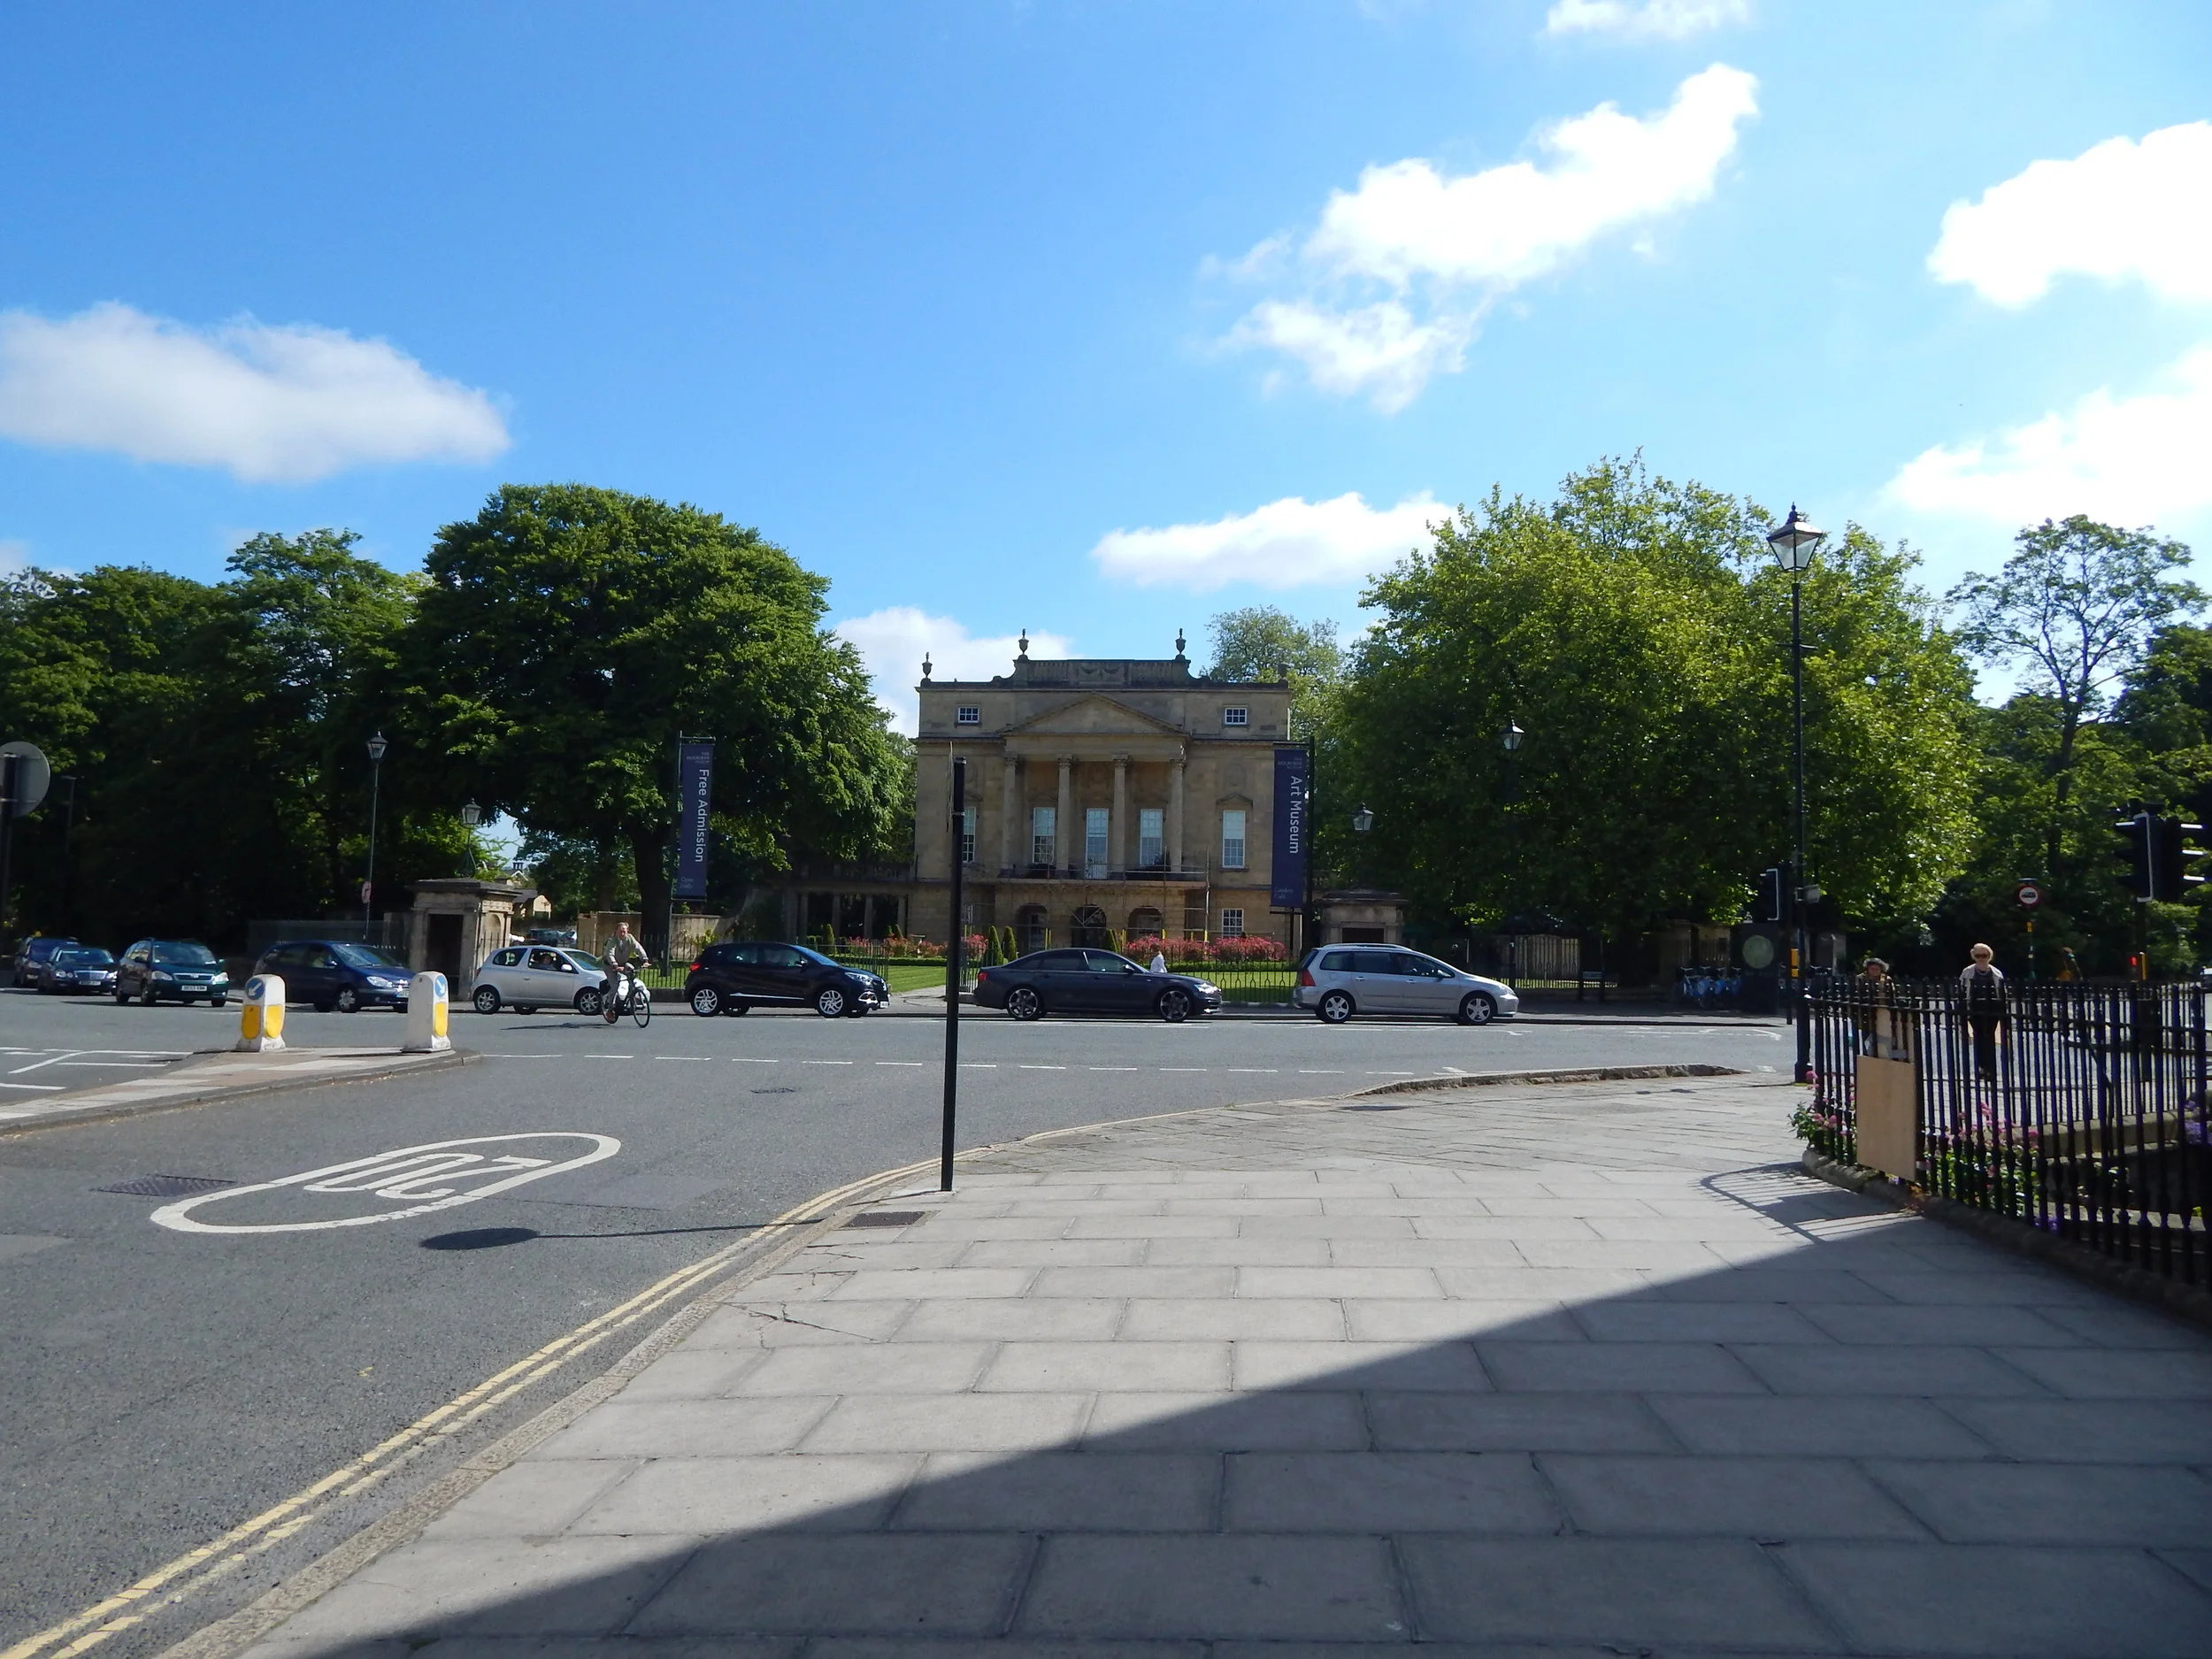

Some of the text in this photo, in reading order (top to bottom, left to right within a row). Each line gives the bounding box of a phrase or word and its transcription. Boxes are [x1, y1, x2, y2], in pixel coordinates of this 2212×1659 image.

[695, 769, 710, 863] Free Admission
[1289, 775, 1302, 854] Art Museum
